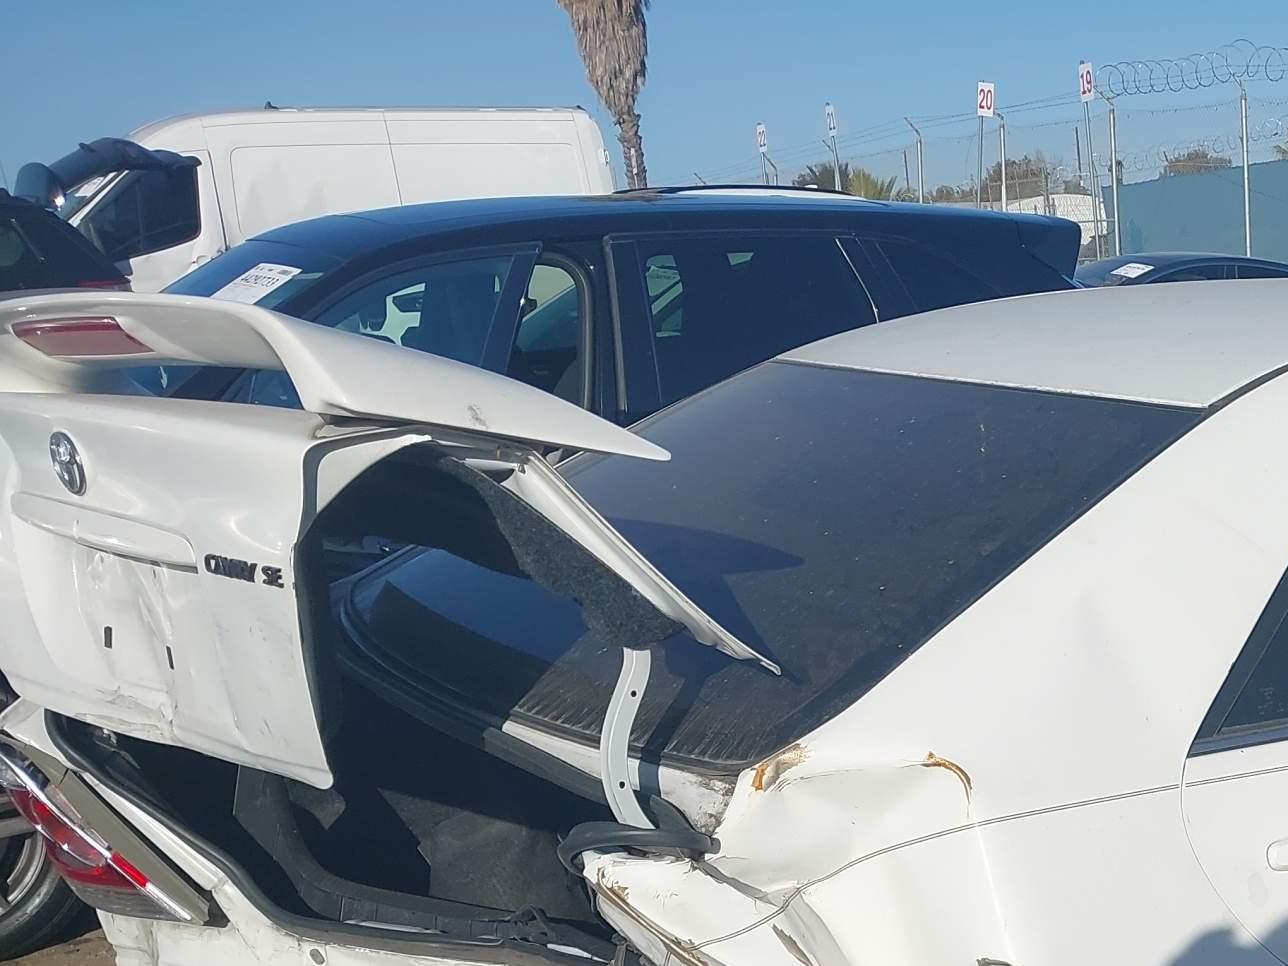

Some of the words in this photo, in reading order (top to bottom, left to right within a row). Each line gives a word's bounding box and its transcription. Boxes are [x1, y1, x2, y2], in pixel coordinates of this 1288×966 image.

[1079, 70, 1093, 95] 19
[978, 88, 993, 110] 20
[261, 565, 285, 589] SE
